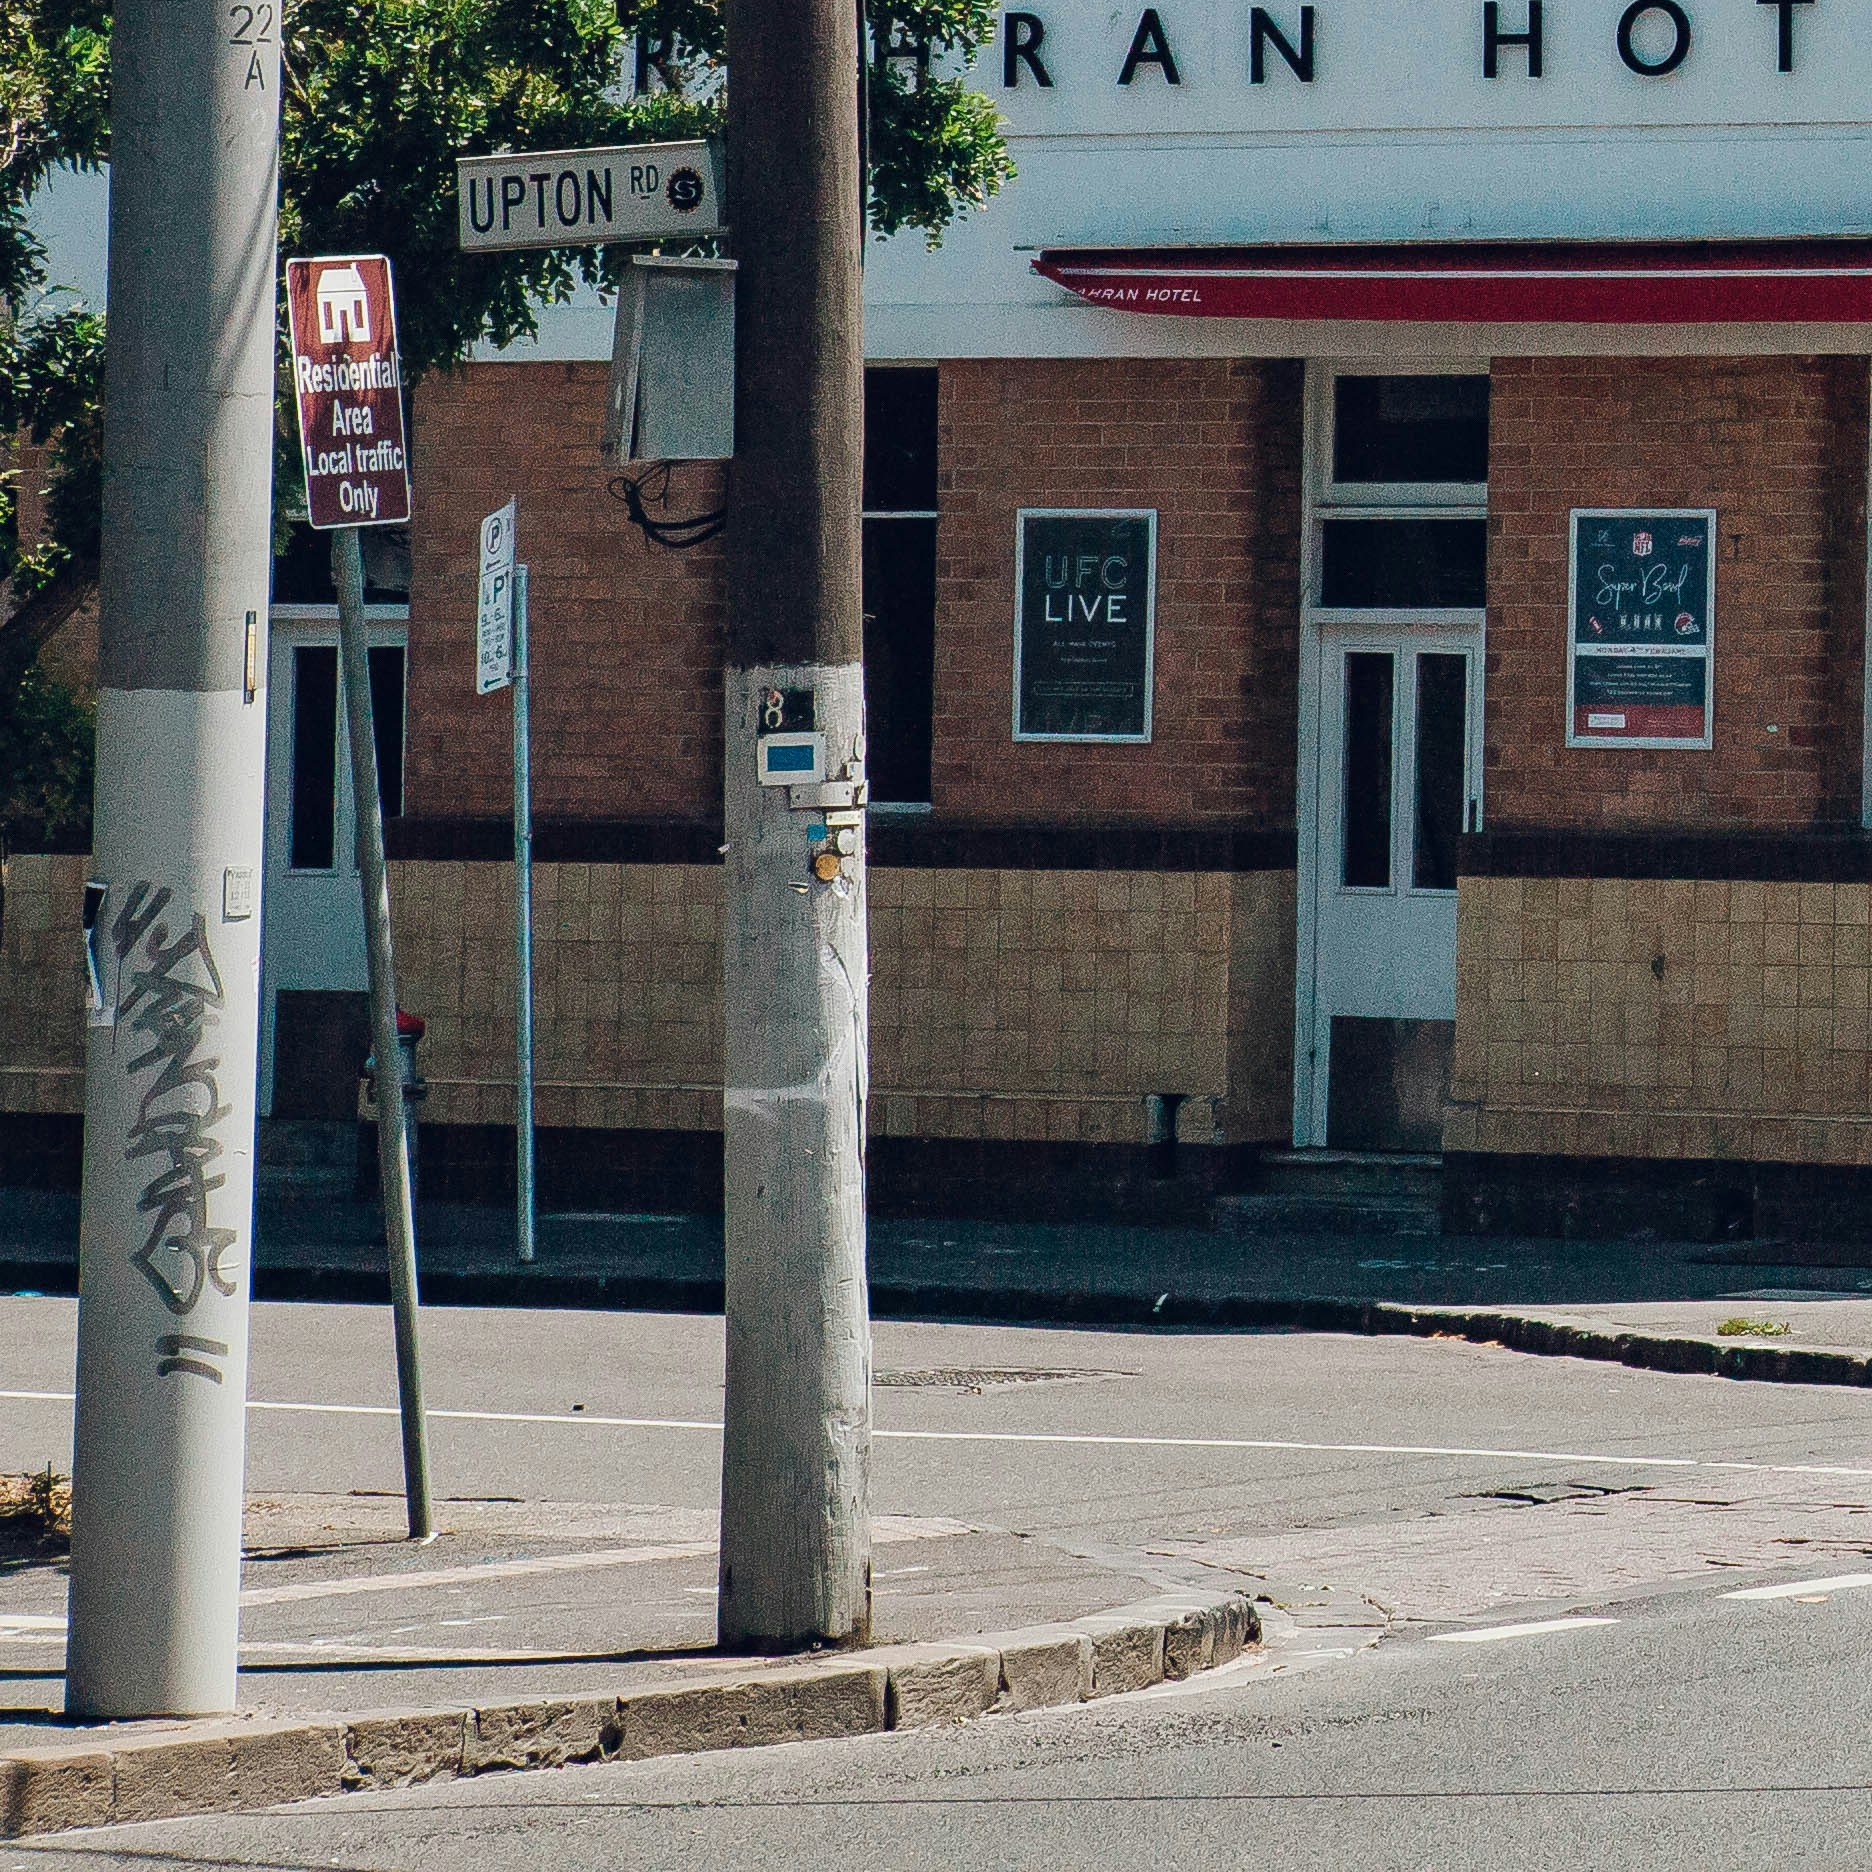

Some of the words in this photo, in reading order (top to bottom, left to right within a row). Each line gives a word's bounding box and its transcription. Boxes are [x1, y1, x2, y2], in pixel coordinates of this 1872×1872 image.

[229, 4, 273, 46] 22
[244, 49, 265, 91] A
[468, 166, 613, 233] UPTON
[630, 164, 659, 199] RD
[1145, 288, 1203, 302] HOTEL
[298, 350, 401, 394] Residential
[332, 399, 374, 437] Area
[306, 442, 352, 477] Local
[355, 439, 403, 473] traffic
[338, 480, 379, 519] Only
[1044, 555, 1128, 590] UFC
[1044, 594, 1128, 623] LIVE
